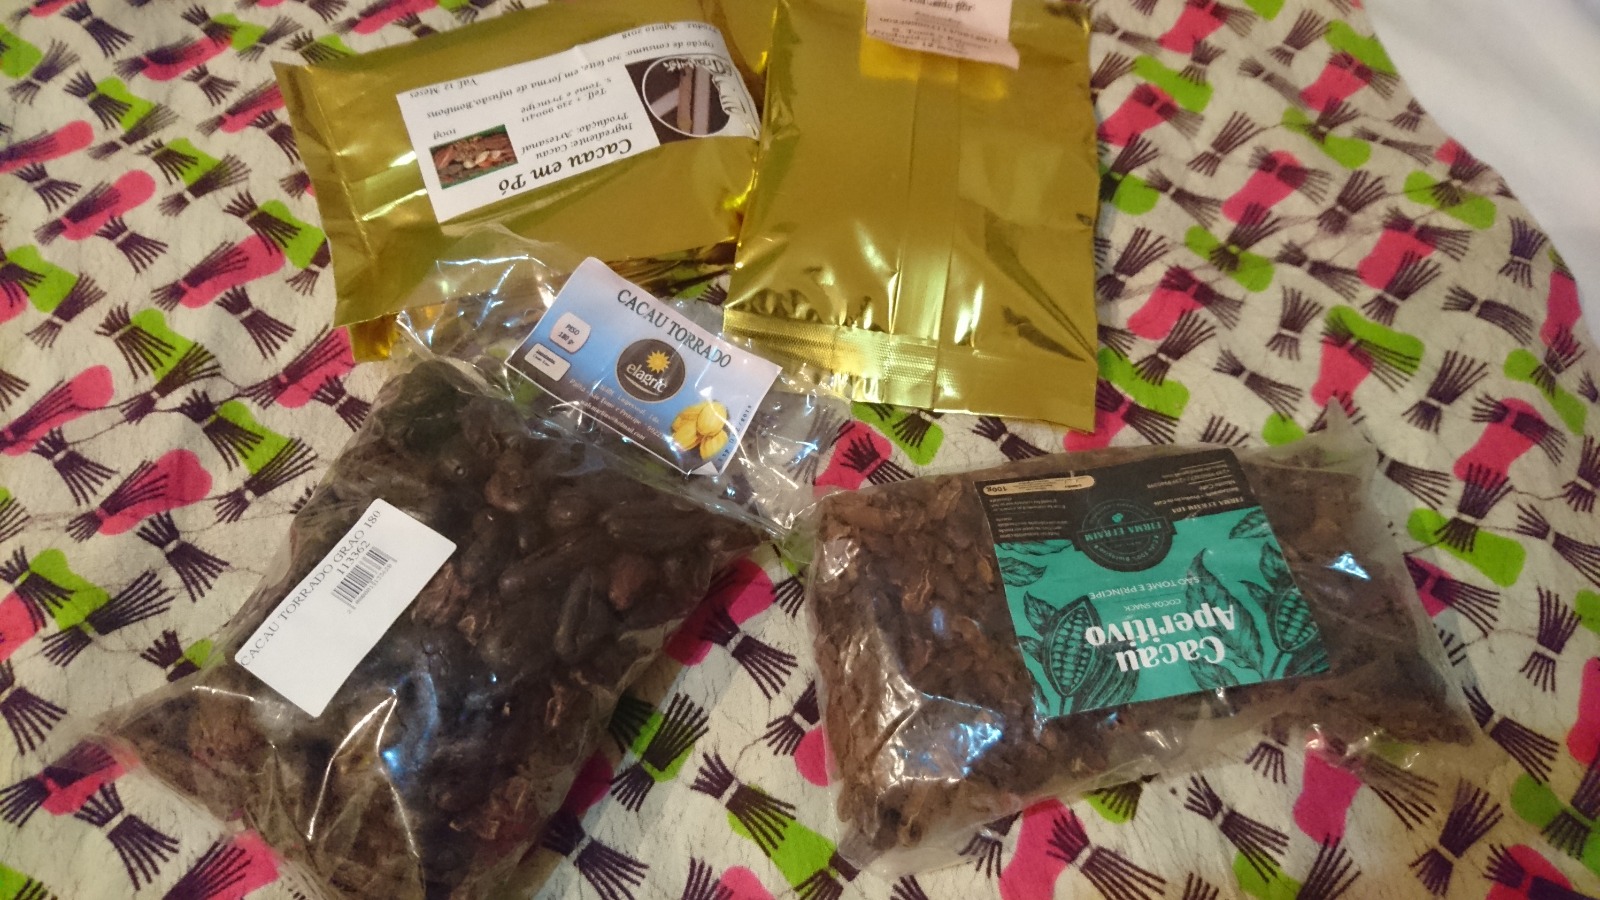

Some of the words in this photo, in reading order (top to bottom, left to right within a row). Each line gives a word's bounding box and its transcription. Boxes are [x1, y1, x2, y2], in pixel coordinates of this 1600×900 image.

[621, 28, 641, 39] 2018
[645, 23, 676, 32] Agosto
[530, 73, 561, 89] forma
[564, 69, 578, 78] em
[409, 87, 438, 98] Meses
[515, 84, 527, 93] de
[576, 112, 627, 133] Produção:
[433, 128, 457, 140] 100g
[520, 129, 573, 154] Artesanal
[569, 122, 633, 149] Ingrediente:
[535, 143, 567, 159] Cacau
[567, 137, 632, 168] Cacau
[529, 160, 561, 179] em
[497, 173, 526, 194] Pó
[565, 323, 580, 335] PESO
[617, 289, 669, 329] CACAU
[668, 322, 731, 368] TORRADO
[626, 362, 668, 392] elagric
[1218, 496, 1243, 505] FIRMA
[1084, 527, 1123, 541] EFRAIM
[1127, 521, 1161, 534] FIRMA
[336, 539, 370, 574] 113362
[240, 622, 280, 667] CACAU
[277, 561, 334, 622] TORRADO
[363, 509, 381, 528] 180
[1088, 585, 1136, 599] PRÍNCIPE
[1146, 579, 1174, 593] TOMÉ
[1123, 602, 1150, 611] SNACK
[1152, 598, 1180, 607] COCOA
[1086, 603, 1235, 647] Aperitivo
[1117, 635, 1224, 671] Cacau
